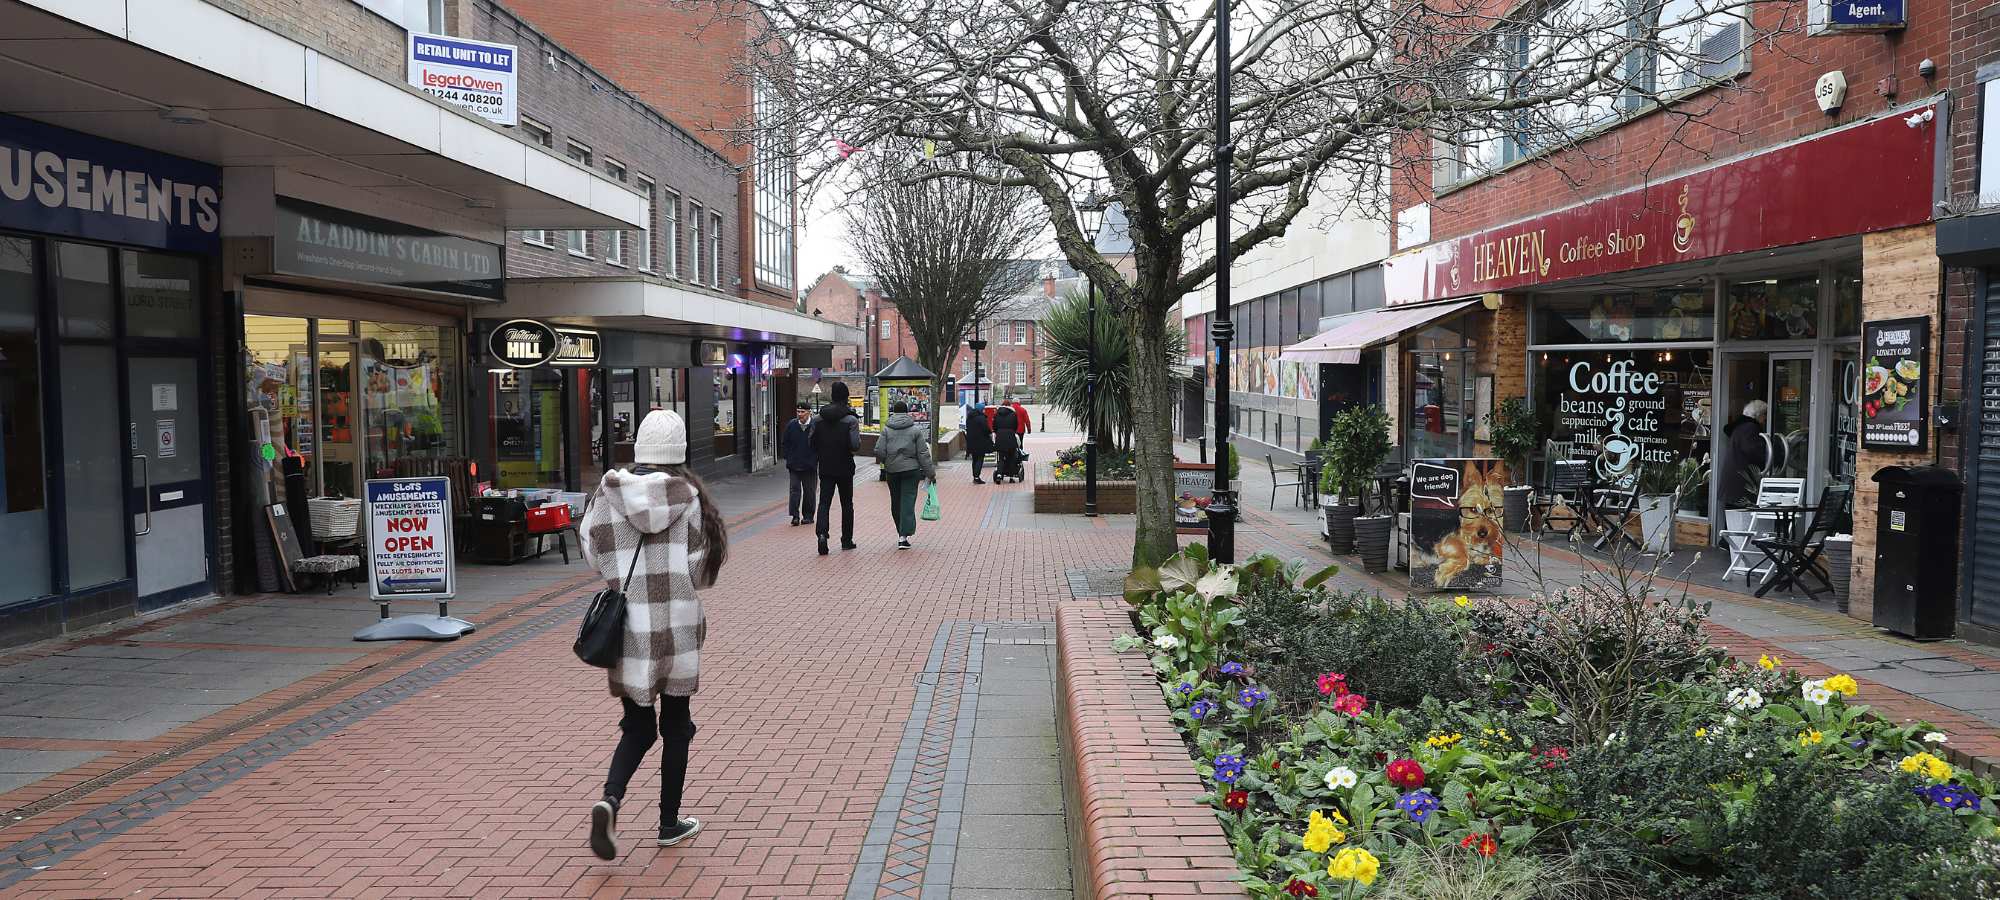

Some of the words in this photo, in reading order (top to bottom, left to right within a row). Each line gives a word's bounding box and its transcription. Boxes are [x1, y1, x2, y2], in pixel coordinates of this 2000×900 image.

[1848, 3, 1885, 18] Agent.
[417, 42, 451, 59] RETAIL
[452, 47, 477, 62] UNIT
[478, 51, 491, 64] TO
[493, 54, 510, 66] LET
[423, 69, 503, 91] LegatOwen
[462, 93, 503, 106] 408200
[0, 146, 218, 233] USEMENTS
[296, 216, 404, 259] ALADDIN'S
[411, 240, 459, 270] CABIN
[464, 249, 490, 274] LTD
[1473, 229, 1547, 282] HEAVEN
[1559, 235, 1604, 264] Coffee
[1607, 228, 1646, 263] Shop
[505, 328, 542, 341] William
[506, 341, 543, 359] HILL
[580, 338, 595, 358] HILL
[1897, 347, 1912, 355] CARD
[1569, 360, 1660, 395] Coffee
[1560, 393, 1605, 414] beans
[1628, 397, 1665, 413] ground
[1561, 415, 1608, 429] cappuccino
[1628, 411, 1659, 432] cafe
[1574, 428, 1602, 445] milk
[1633, 435, 1668, 444] americano
[1568, 446, 1598, 456] machiato
[1640, 443, 1672, 463] latte
[1178, 477, 1214, 490] HEAVEN
[1416, 475, 1428, 483] We
[1440, 473, 1454, 481] dog
[1424, 481, 1450, 490] friendly
[376, 491, 438, 502] AMUSEMENTS
[386, 516, 428, 533] NOW
[384, 535, 434, 553] OPEN
[406, 559, 444, 567] CONDITIONED
[414, 568, 425, 576] 10p
